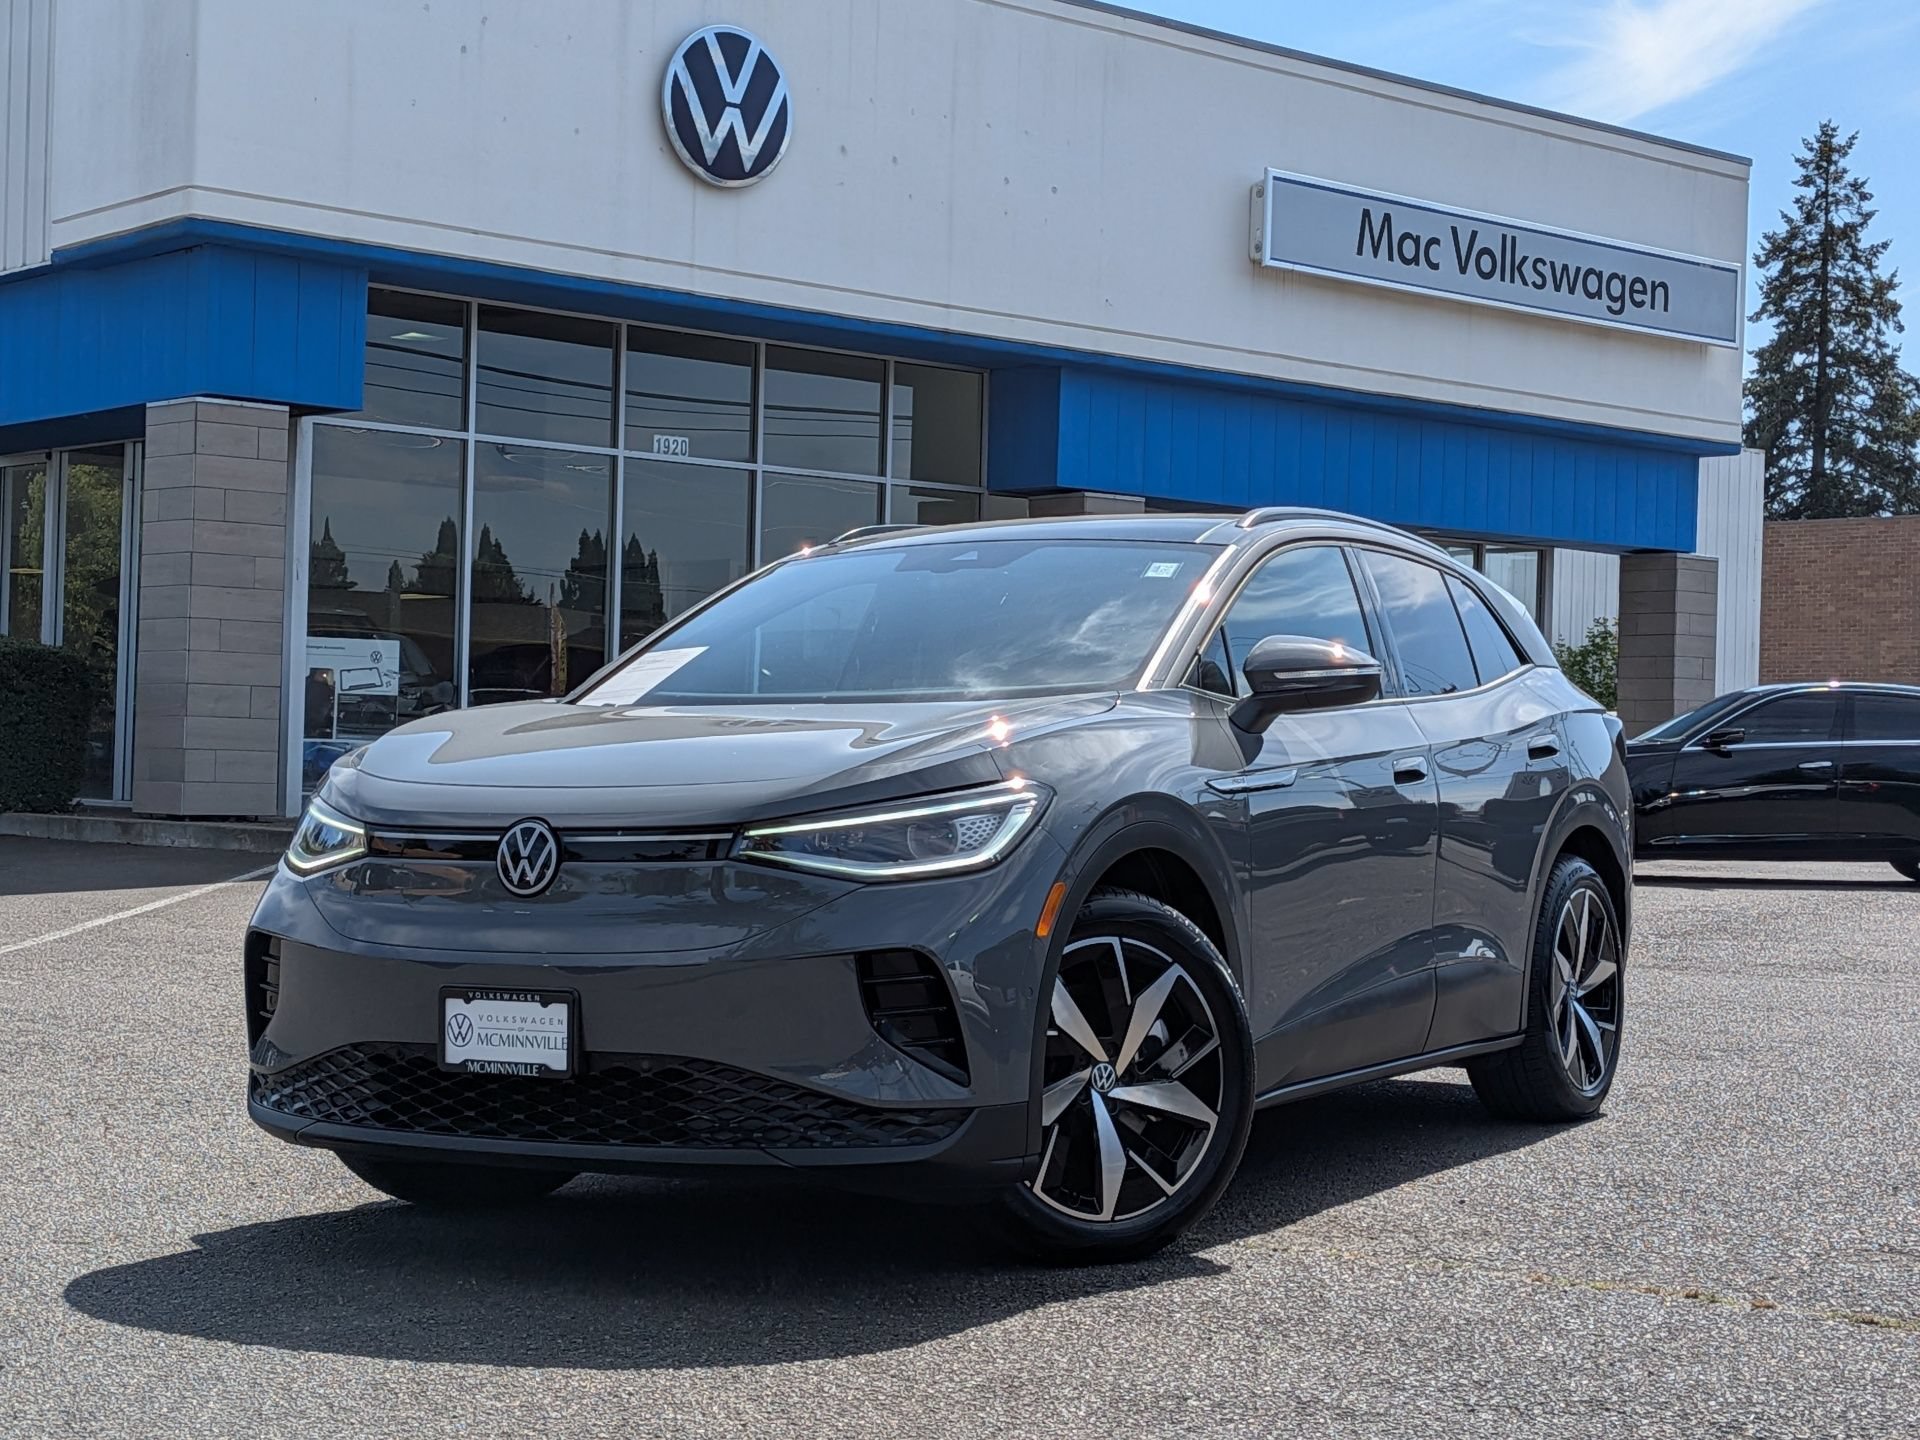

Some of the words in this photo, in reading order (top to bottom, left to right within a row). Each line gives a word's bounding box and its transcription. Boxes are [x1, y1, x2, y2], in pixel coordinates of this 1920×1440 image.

[1356, 208, 1441, 272] Mac
[1450, 225, 1670, 315] Volkswagen
[655, 437, 688, 457] 1920
[467, 991, 541, 1002] VOLKSWAGEN
[478, 1014, 564, 1026] VOLKSWAGEN
[476, 1033, 568, 1051] MCMINNVILLE
[466, 1060, 540, 1077] MCMINNVILLE
